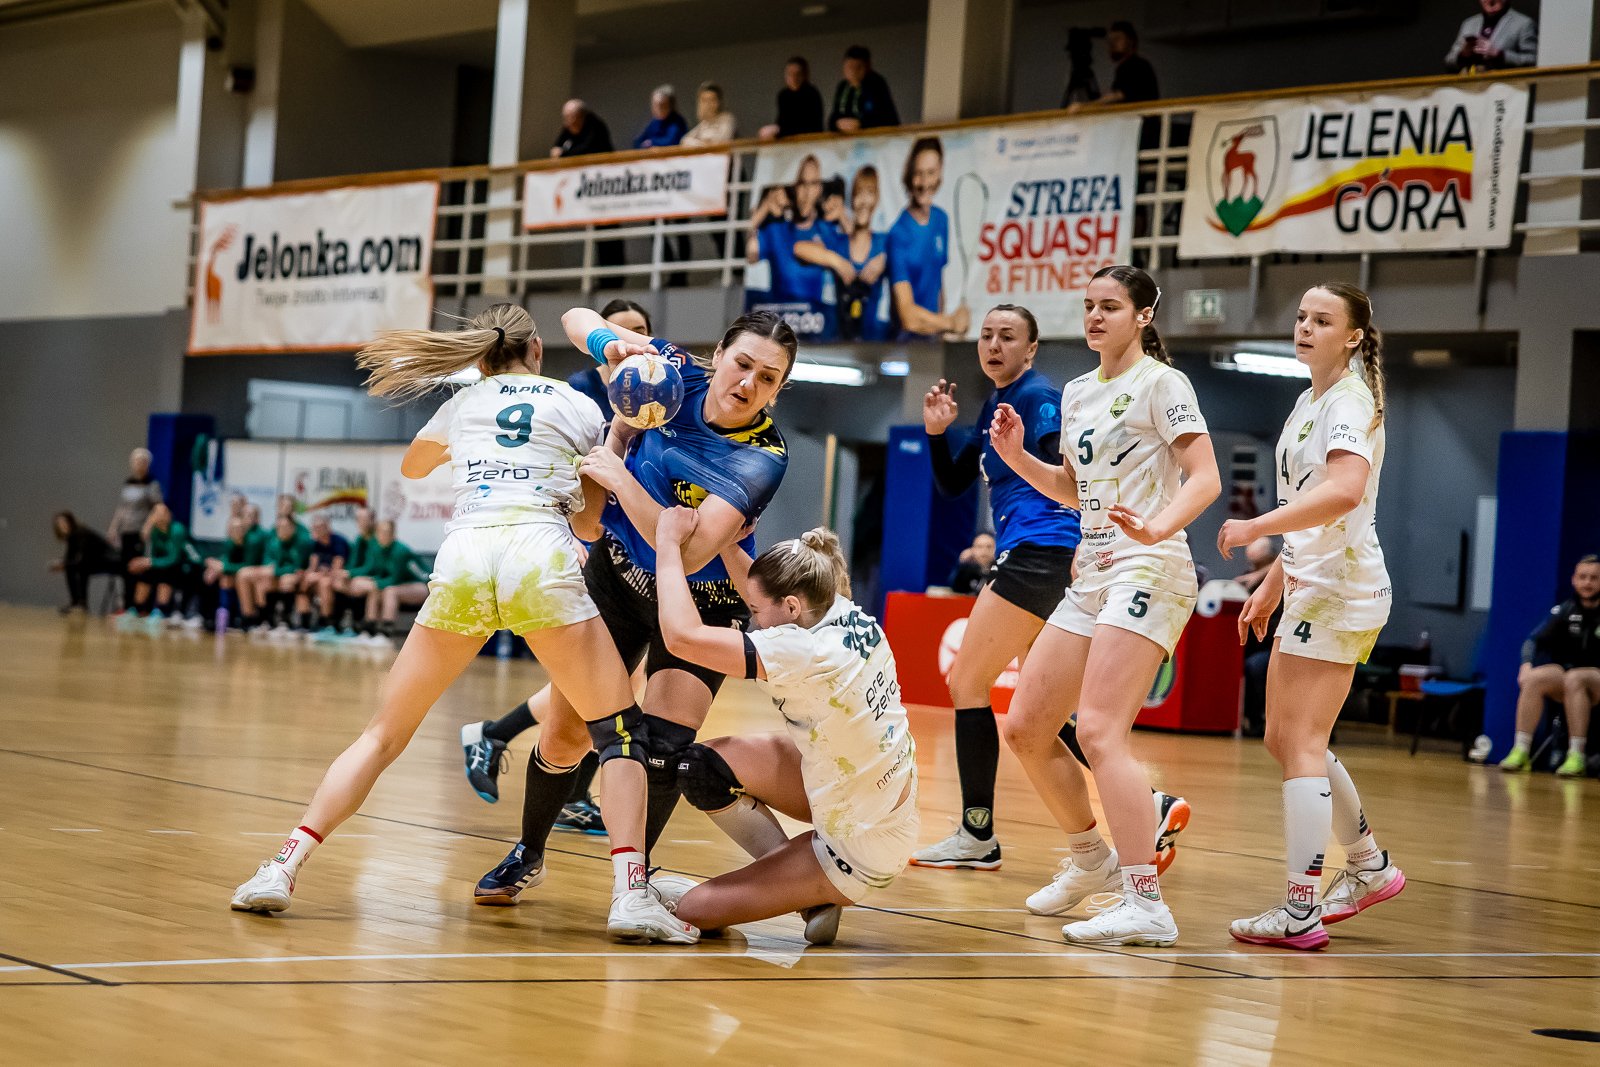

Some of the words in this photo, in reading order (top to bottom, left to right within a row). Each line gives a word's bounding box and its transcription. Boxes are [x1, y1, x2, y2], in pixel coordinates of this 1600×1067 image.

[1292, 104, 1474, 160] JELENIA
[576, 167, 692, 199] Jelonka.com
[1007, 174, 1122, 218] STREFA
[1335, 167, 1467, 234] GÓRA
[236, 228, 422, 282] Jelonka.com
[978, 215, 1120, 262] SQUASH
[986, 263, 1000, 294] &
[495, 403, 535, 448] 9
[1166, 404, 1188, 420] pre
[1170, 414, 1197, 427] zero
[1078, 428, 1095, 466] 5
[1281, 447, 1290, 485] 4
[466, 468, 530, 483] zero
[1128, 590, 1151, 618] 5
[1293, 620, 1312, 643] 4
[866, 671, 885, 708] pre
[872, 680, 897, 721] zero
